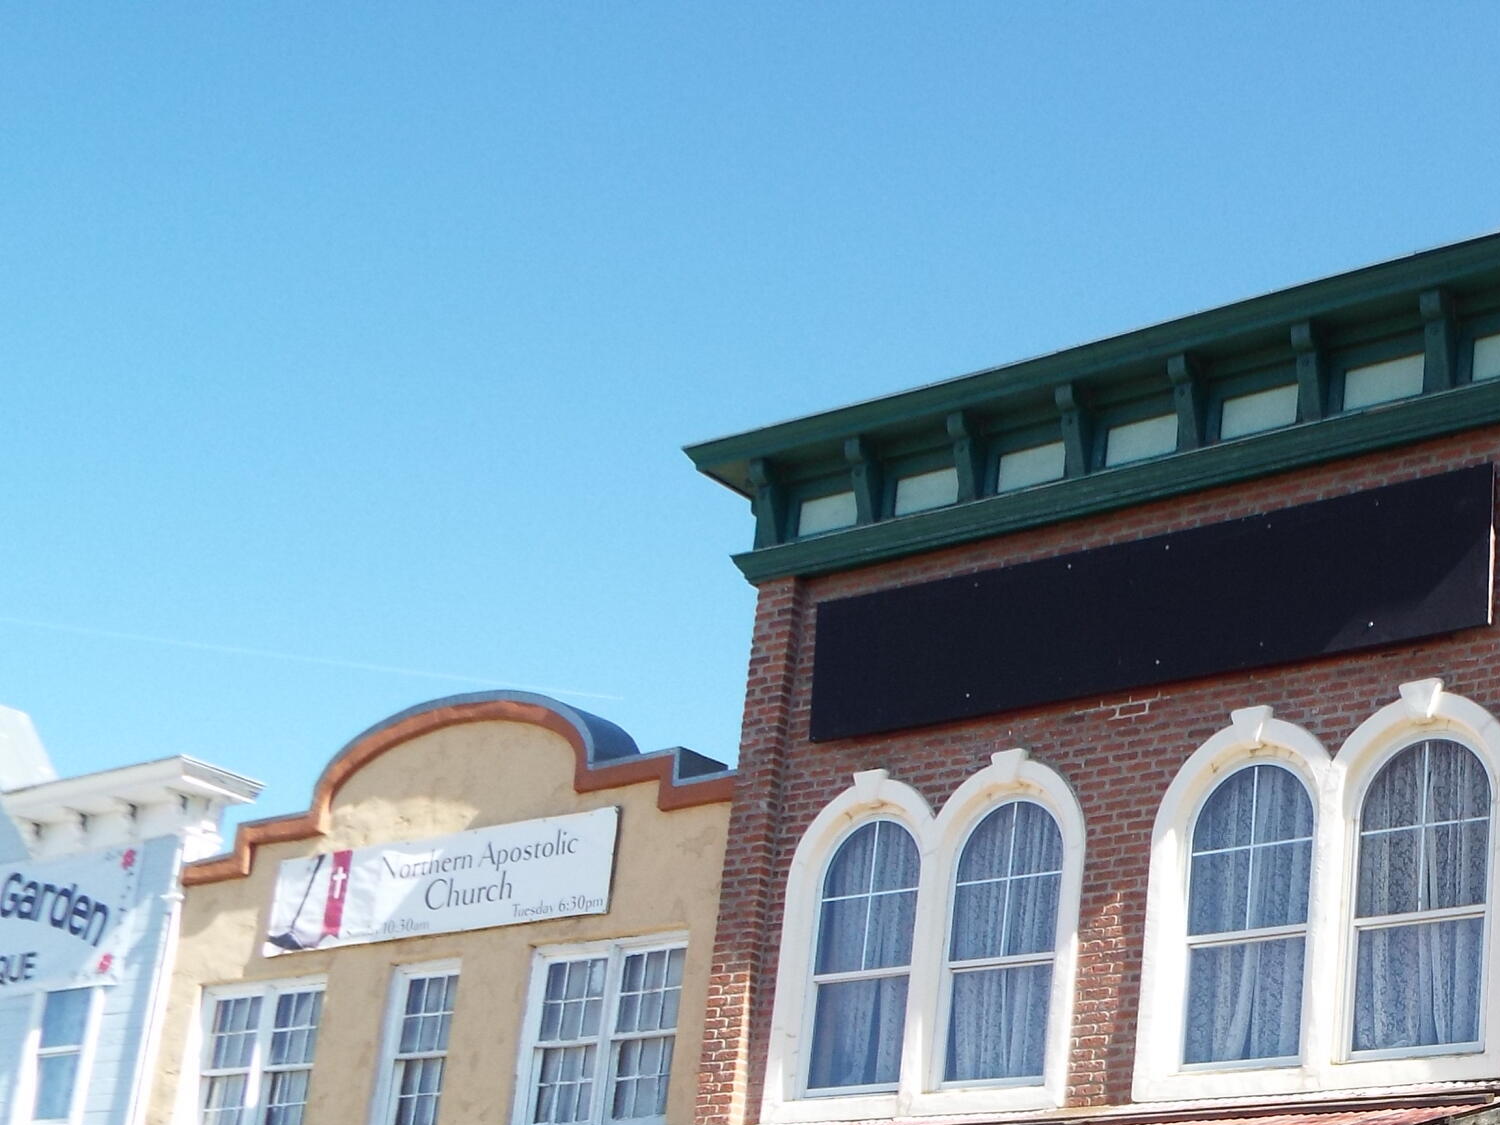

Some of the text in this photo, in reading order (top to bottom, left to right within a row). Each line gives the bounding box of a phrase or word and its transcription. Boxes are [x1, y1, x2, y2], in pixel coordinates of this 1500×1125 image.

[382, 827, 580, 879] Northern Apostolic
[0, 872, 109, 947] Garden
[424, 869, 513, 911] Church
[558, 894, 604, 912] 6:30pm
